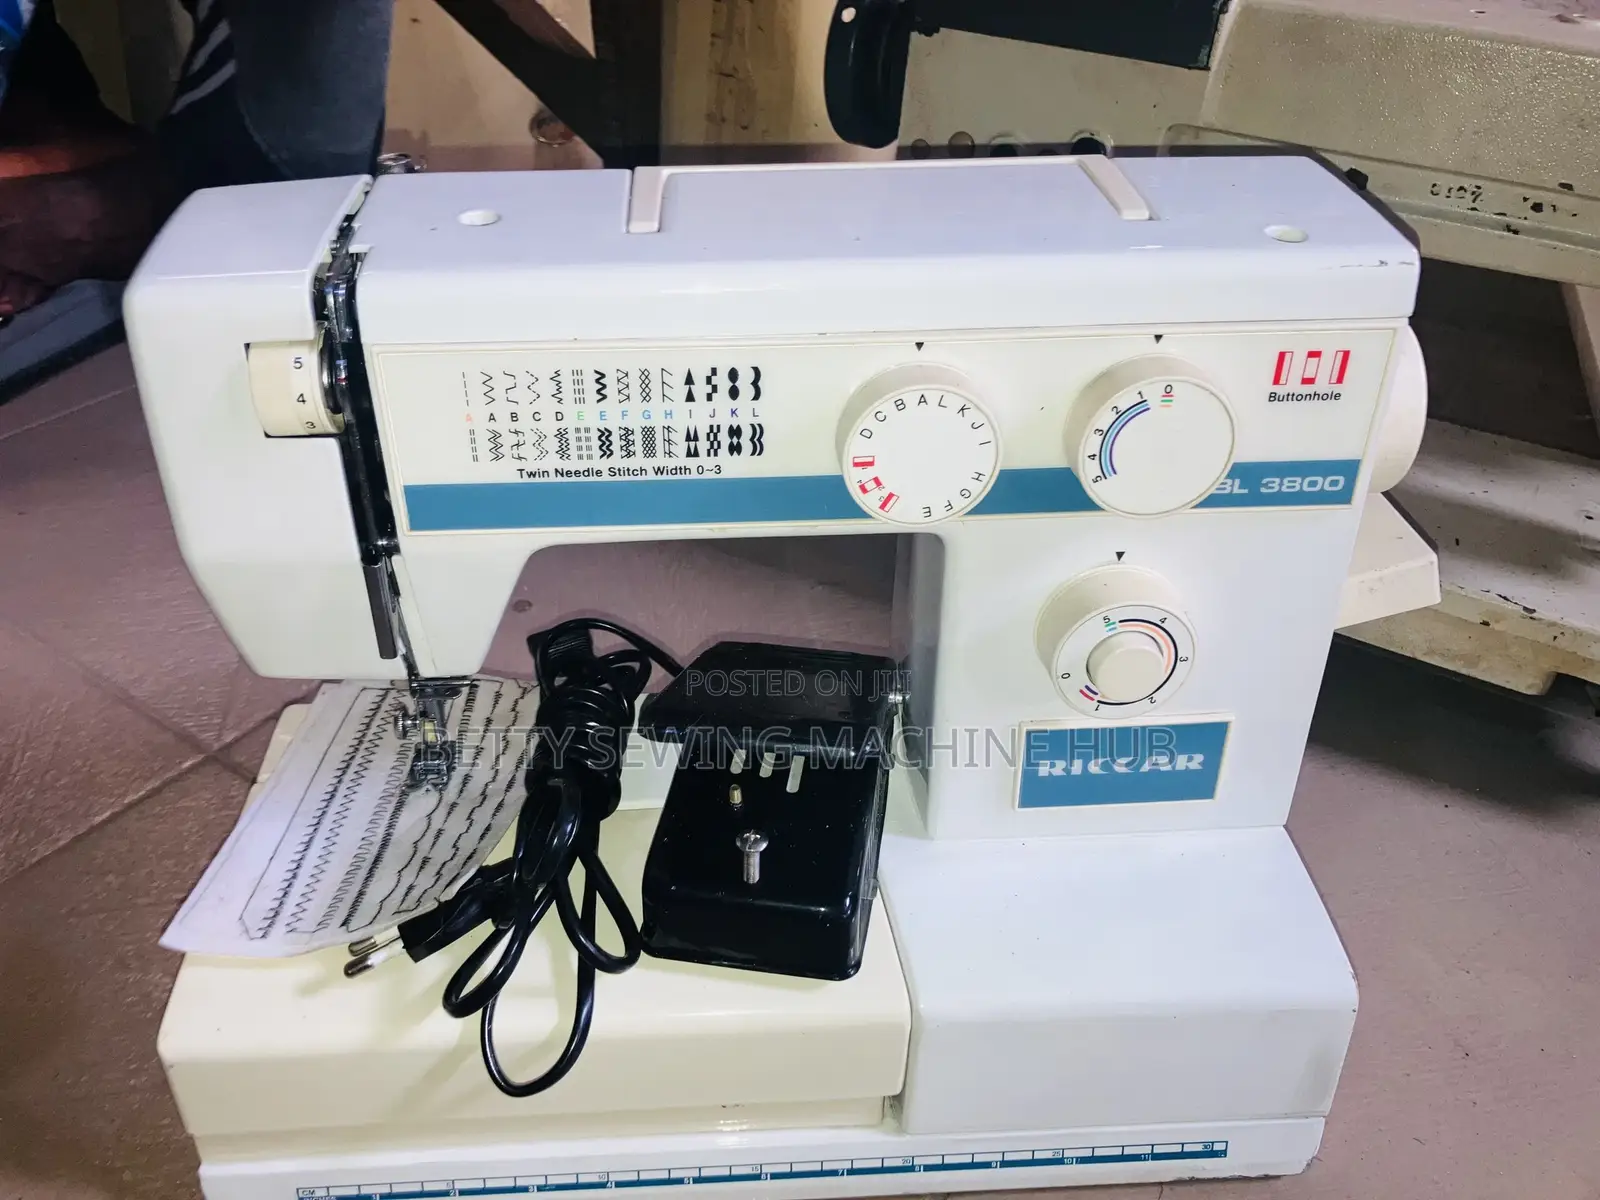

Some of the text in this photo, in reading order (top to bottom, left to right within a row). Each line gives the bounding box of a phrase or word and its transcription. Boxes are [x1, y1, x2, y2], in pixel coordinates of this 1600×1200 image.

[293, 357, 303, 370] 5
[1137, 390, 1144, 399] 1
[1164, 384, 1173, 394] 0
[296, 393, 306, 405] 4
[1268, 390, 1342, 403] Buttonhole
[465, 413, 473, 423] A
[488, 412, 497, 423] A
[510, 412, 519, 422] B
[532, 411, 542, 422] C
[555, 411, 564, 421] D
[577, 410, 585, 421] E
[600, 410, 607, 420] E
[621, 410, 629, 420] F
[642, 409, 651, 420] G
[665, 409, 673, 419] H
[709, 408, 716, 419] J
[730, 408, 739, 418] K
[752, 407, 759, 418] L
[859, 428, 873, 439] D
[874, 411, 887, 422] C
[894, 398, 906, 411] B
[917, 394, 928, 406] A
[938, 395, 947, 408] L
[957, 404, 971, 417] K
[971, 421, 985, 430] J
[1111, 405, 1122, 415] 2
[305, 421, 316, 429] 3
[1094, 428, 1105, 437] 3
[517, 467, 550, 479] Twin
[554, 466, 603, 478] Needle
[608, 465, 648, 477] Stitch
[652, 464, 692, 476] Width
[1092, 475, 1103, 484] 5
[1259, 475, 1345, 493] 3800
[922, 471, 986, 518] H G F E
[1061, 615, 1188, 712] 5 4 3 2 1 0
[1038, 753, 1205, 777] RICCAR
